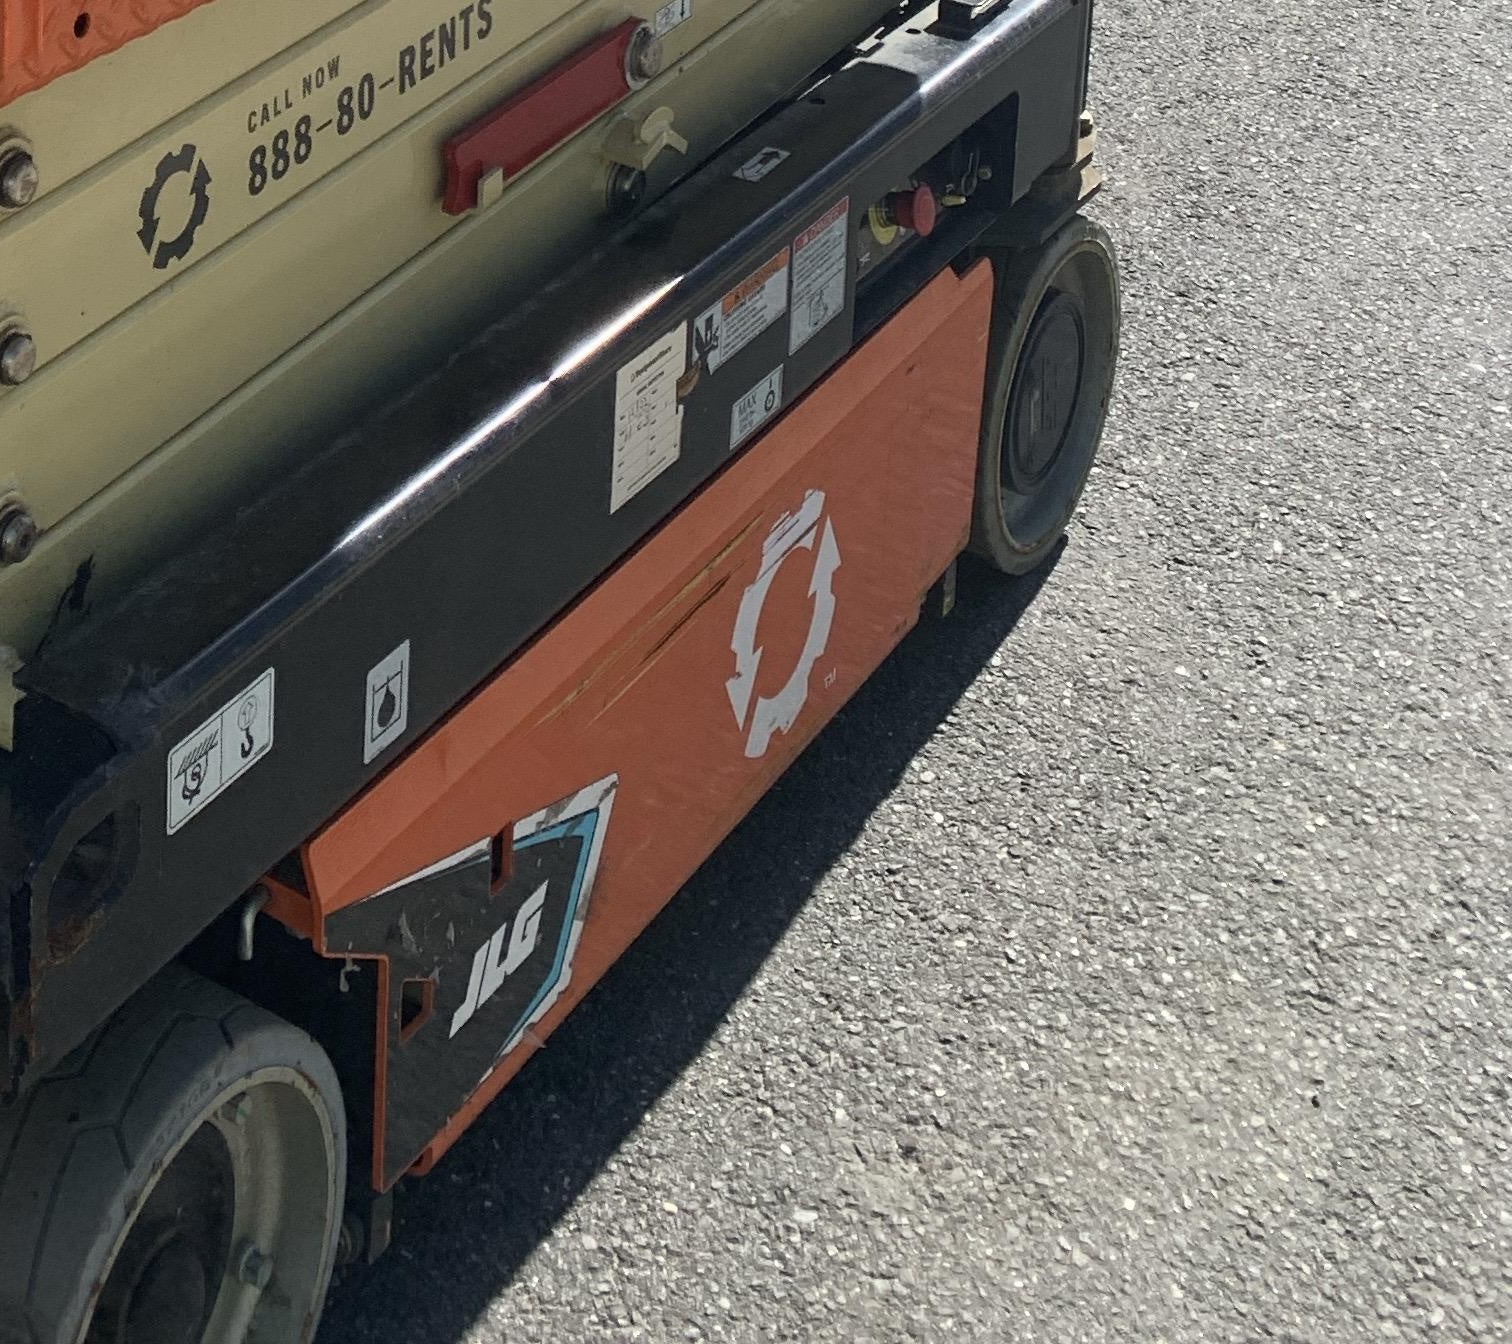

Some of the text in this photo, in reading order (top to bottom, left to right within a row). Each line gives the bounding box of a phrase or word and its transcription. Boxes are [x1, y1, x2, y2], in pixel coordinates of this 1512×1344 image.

[247, 55, 340, 134] CALL NOW
[449, 879, 549, 1039] JLG
